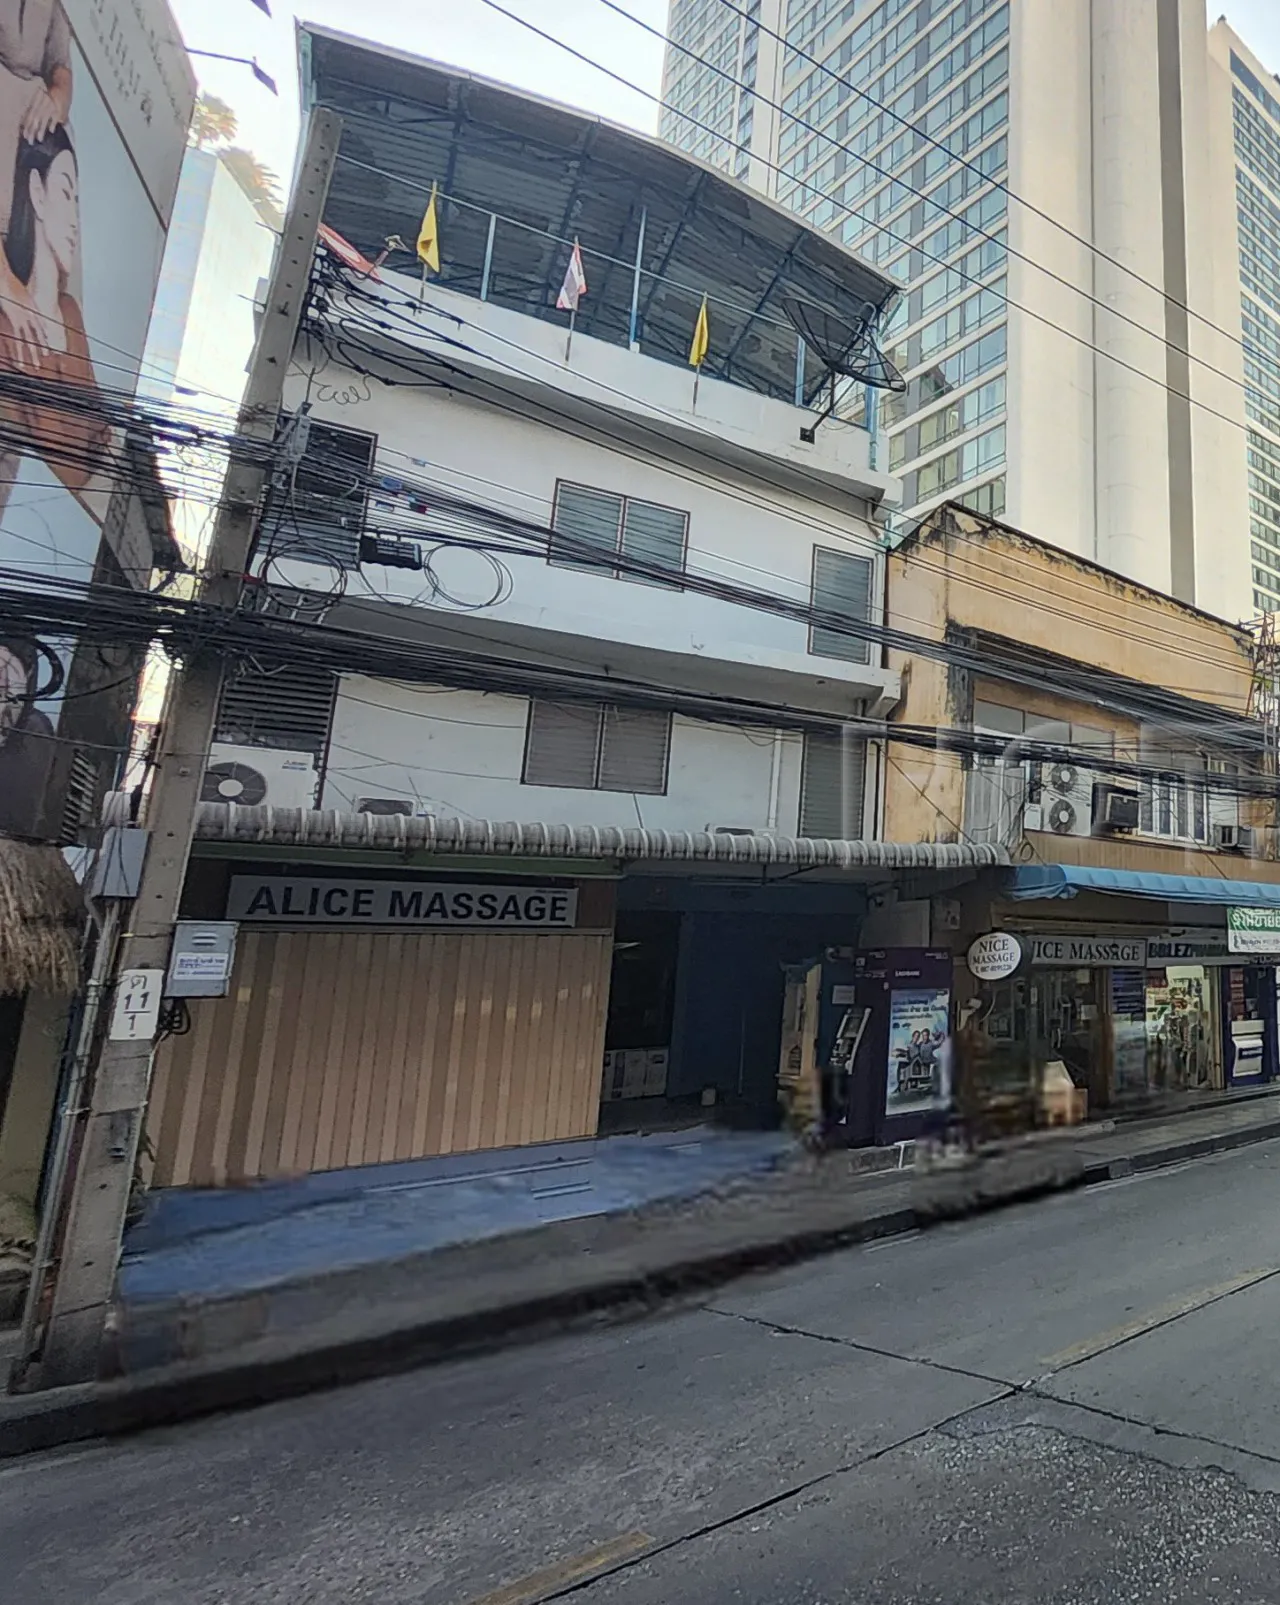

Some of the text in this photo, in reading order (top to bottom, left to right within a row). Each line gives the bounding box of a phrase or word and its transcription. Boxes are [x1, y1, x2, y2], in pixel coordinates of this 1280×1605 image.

[246, 885, 569, 923] ALICE MASSAGE
[978, 938, 1009, 954] NICE
[1070, 942, 1140, 962] MASSAGE
[972, 952, 1015, 965] MASSAGE
[124, 991, 150, 1010] 11
